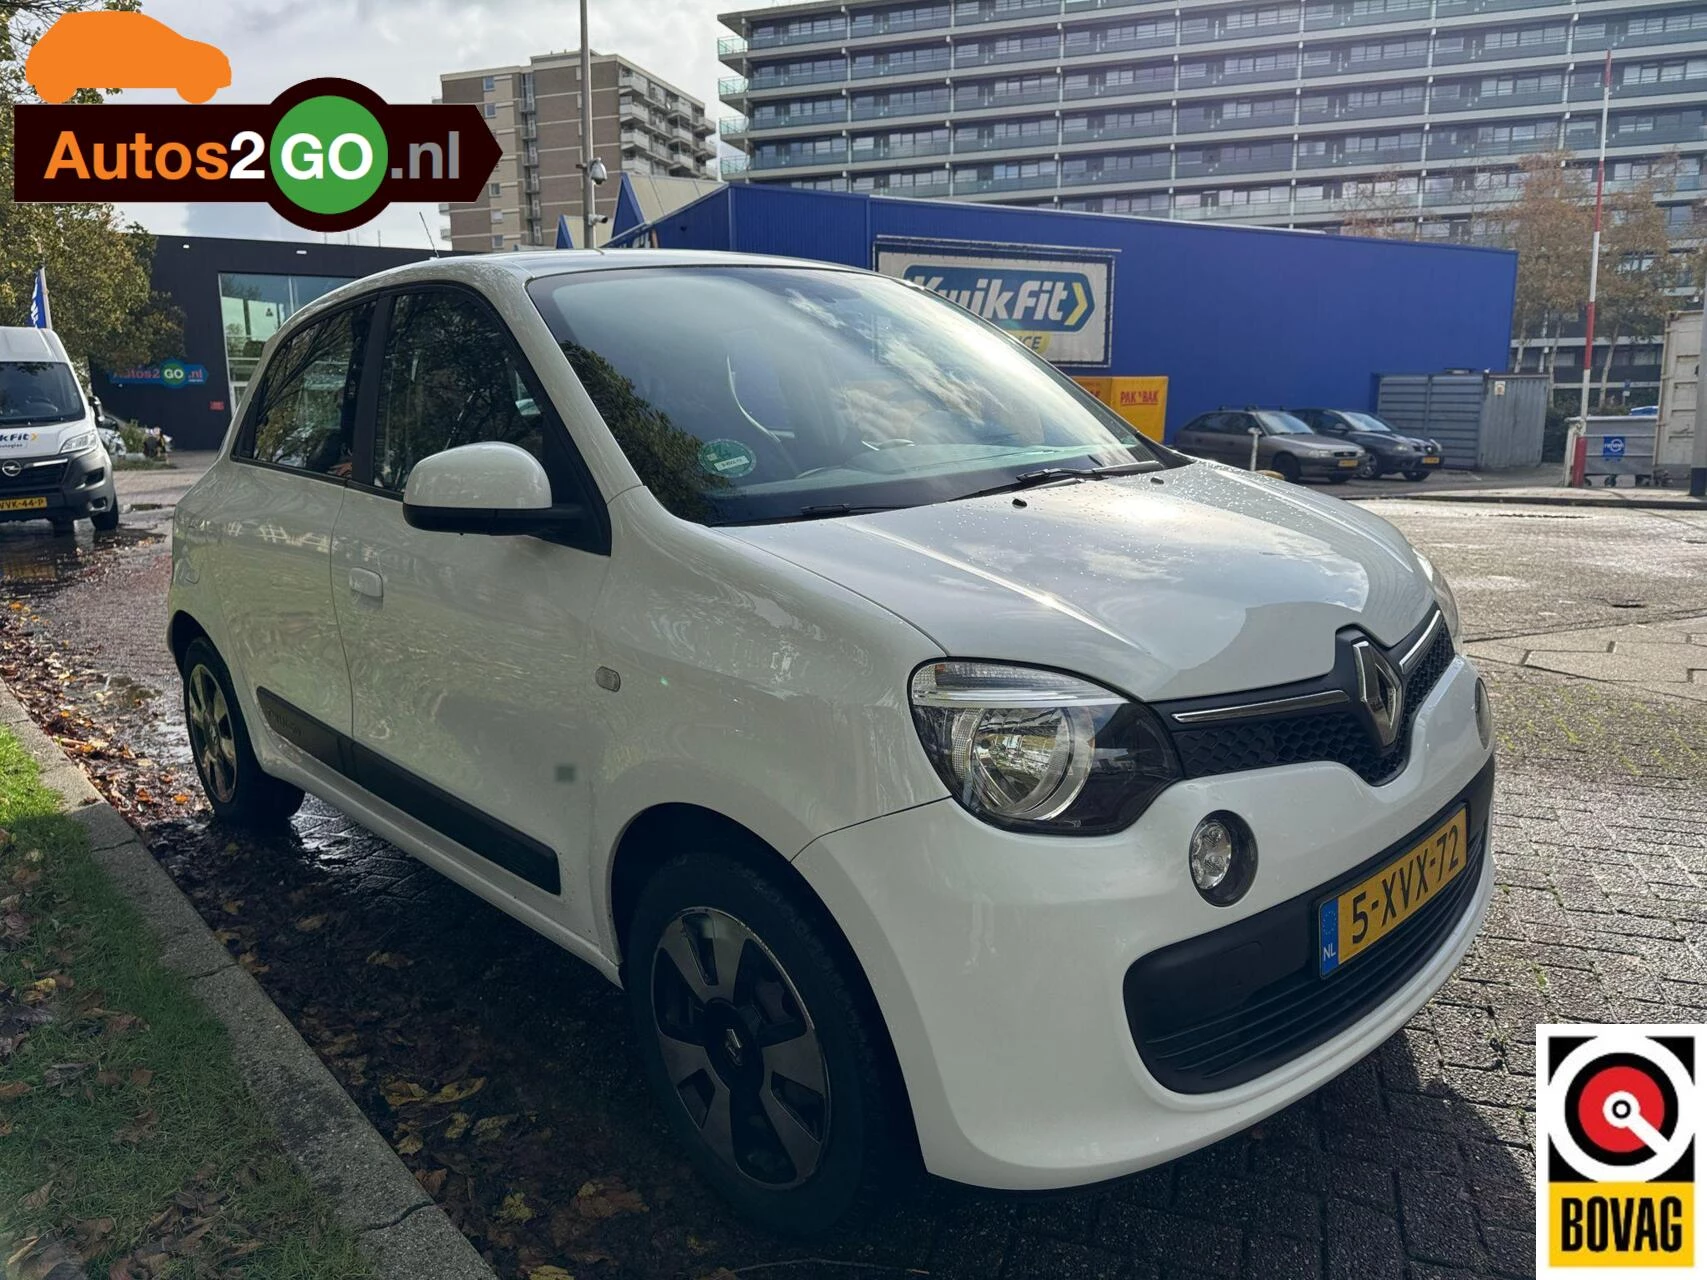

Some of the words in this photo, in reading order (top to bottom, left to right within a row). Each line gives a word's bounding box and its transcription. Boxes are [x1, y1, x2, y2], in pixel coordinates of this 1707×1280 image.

[112, 366, 203, 379] tos2GO.nl
[1352, 824, 1459, 945] 5-XVX-72
[1323, 942, 1336, 961] NL
